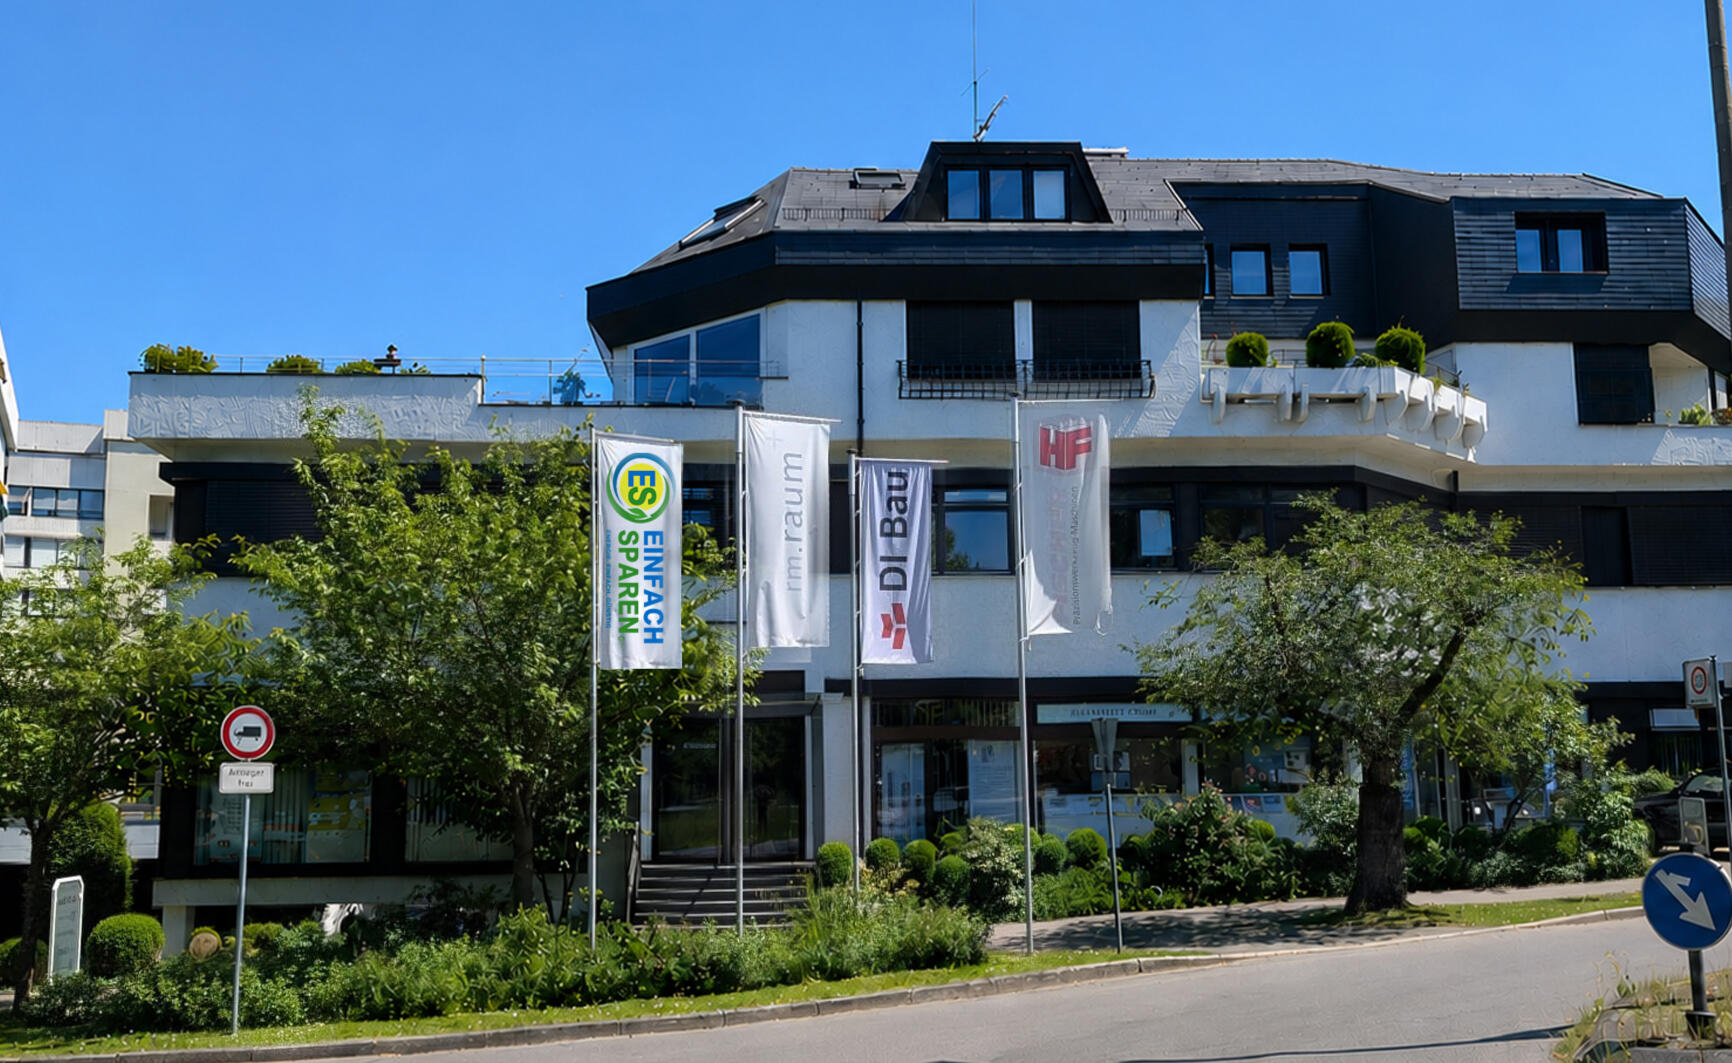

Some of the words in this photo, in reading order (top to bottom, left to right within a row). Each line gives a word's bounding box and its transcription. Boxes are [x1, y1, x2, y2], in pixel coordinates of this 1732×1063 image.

[1040, 426, 1092, 470] HF
[628, 470, 657, 506] ES
[784, 452, 803, 592] rm.raum
[879, 471, 908, 539] Bau
[618, 530, 639, 633] SPAREN
[643, 531, 664, 644] EINFACH
[879, 555, 908, 591] DI
